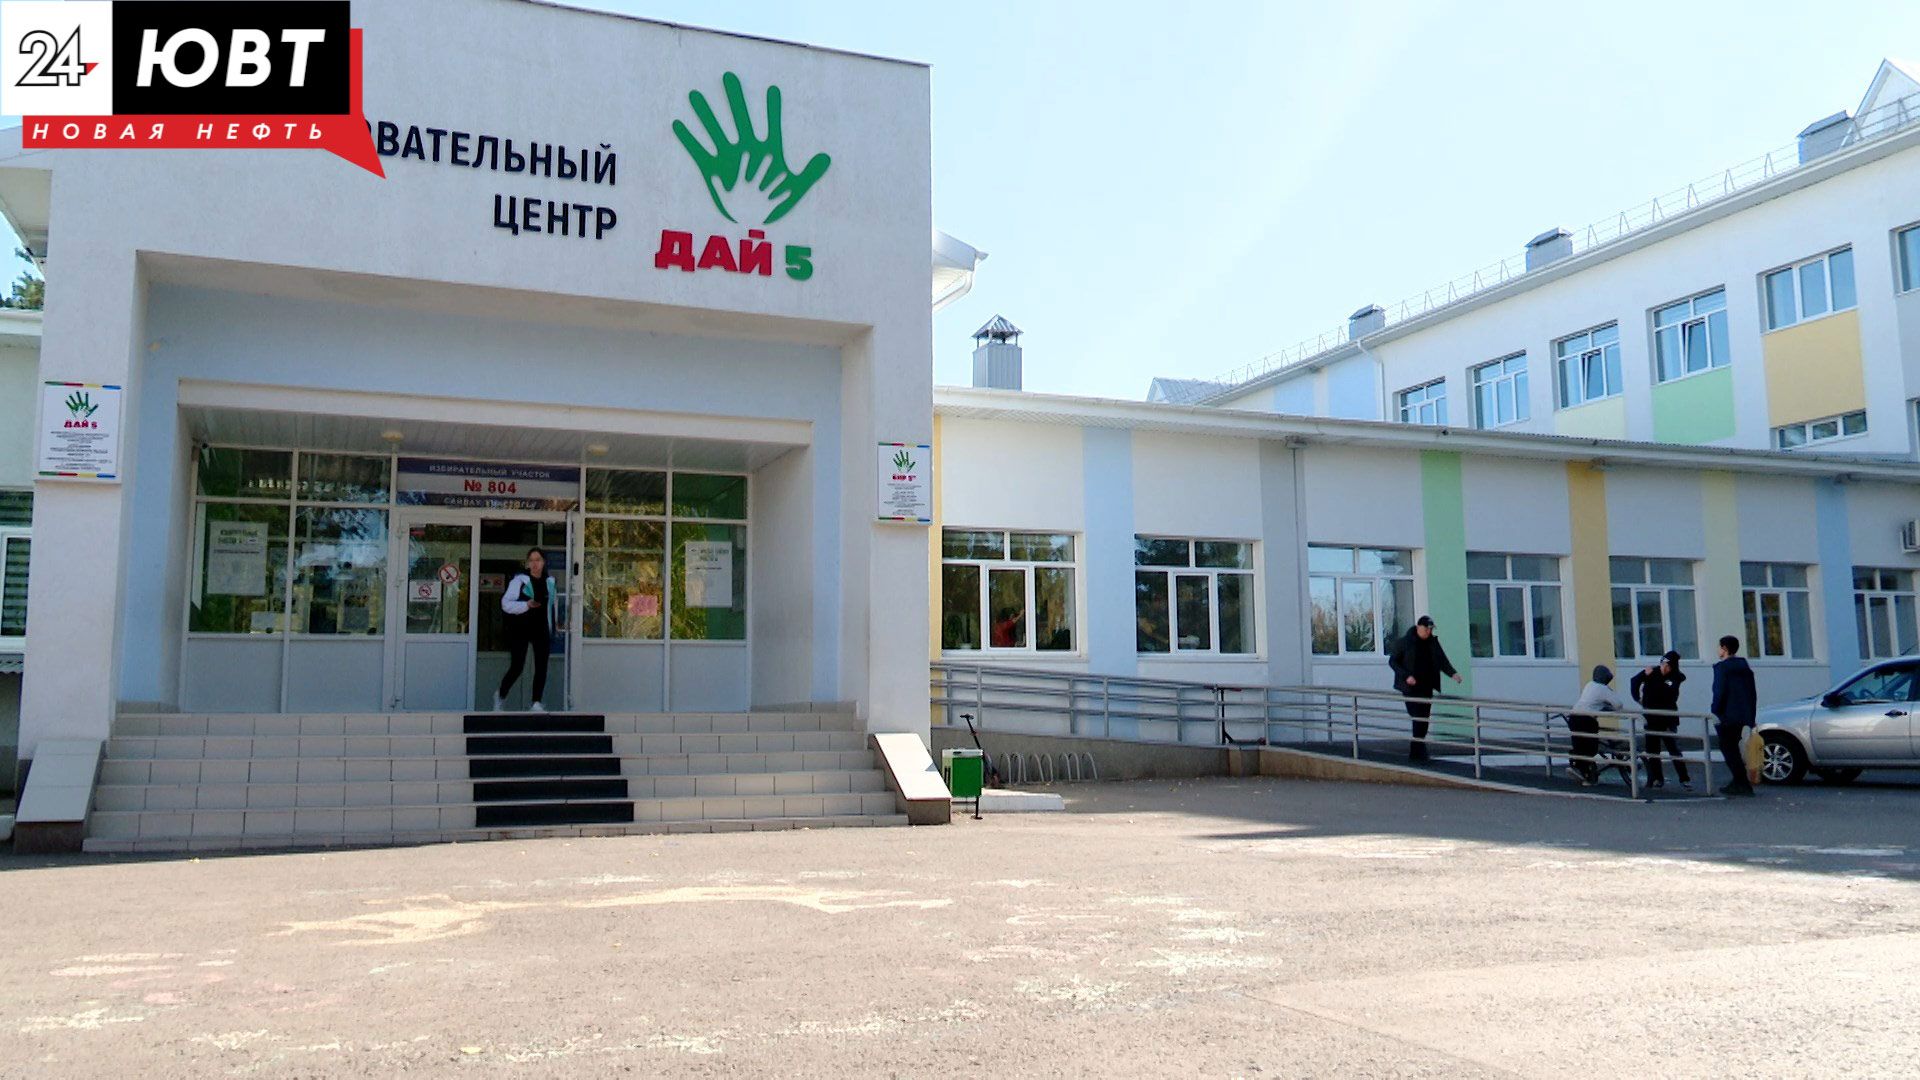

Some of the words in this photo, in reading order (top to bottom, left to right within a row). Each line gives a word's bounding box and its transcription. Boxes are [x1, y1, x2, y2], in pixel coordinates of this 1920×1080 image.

[493, 194, 617, 240] ЦЕНТР
[654, 229, 772, 276] ДАЙ
[785, 245, 814, 281] 5
[429, 464, 507, 476] ИЗБИРАТЕЛЬНЫЙ
[512, 468, 550, 479] УЧАСТОК
[464, 479, 482, 492] №
[488, 481, 517, 494] 804
